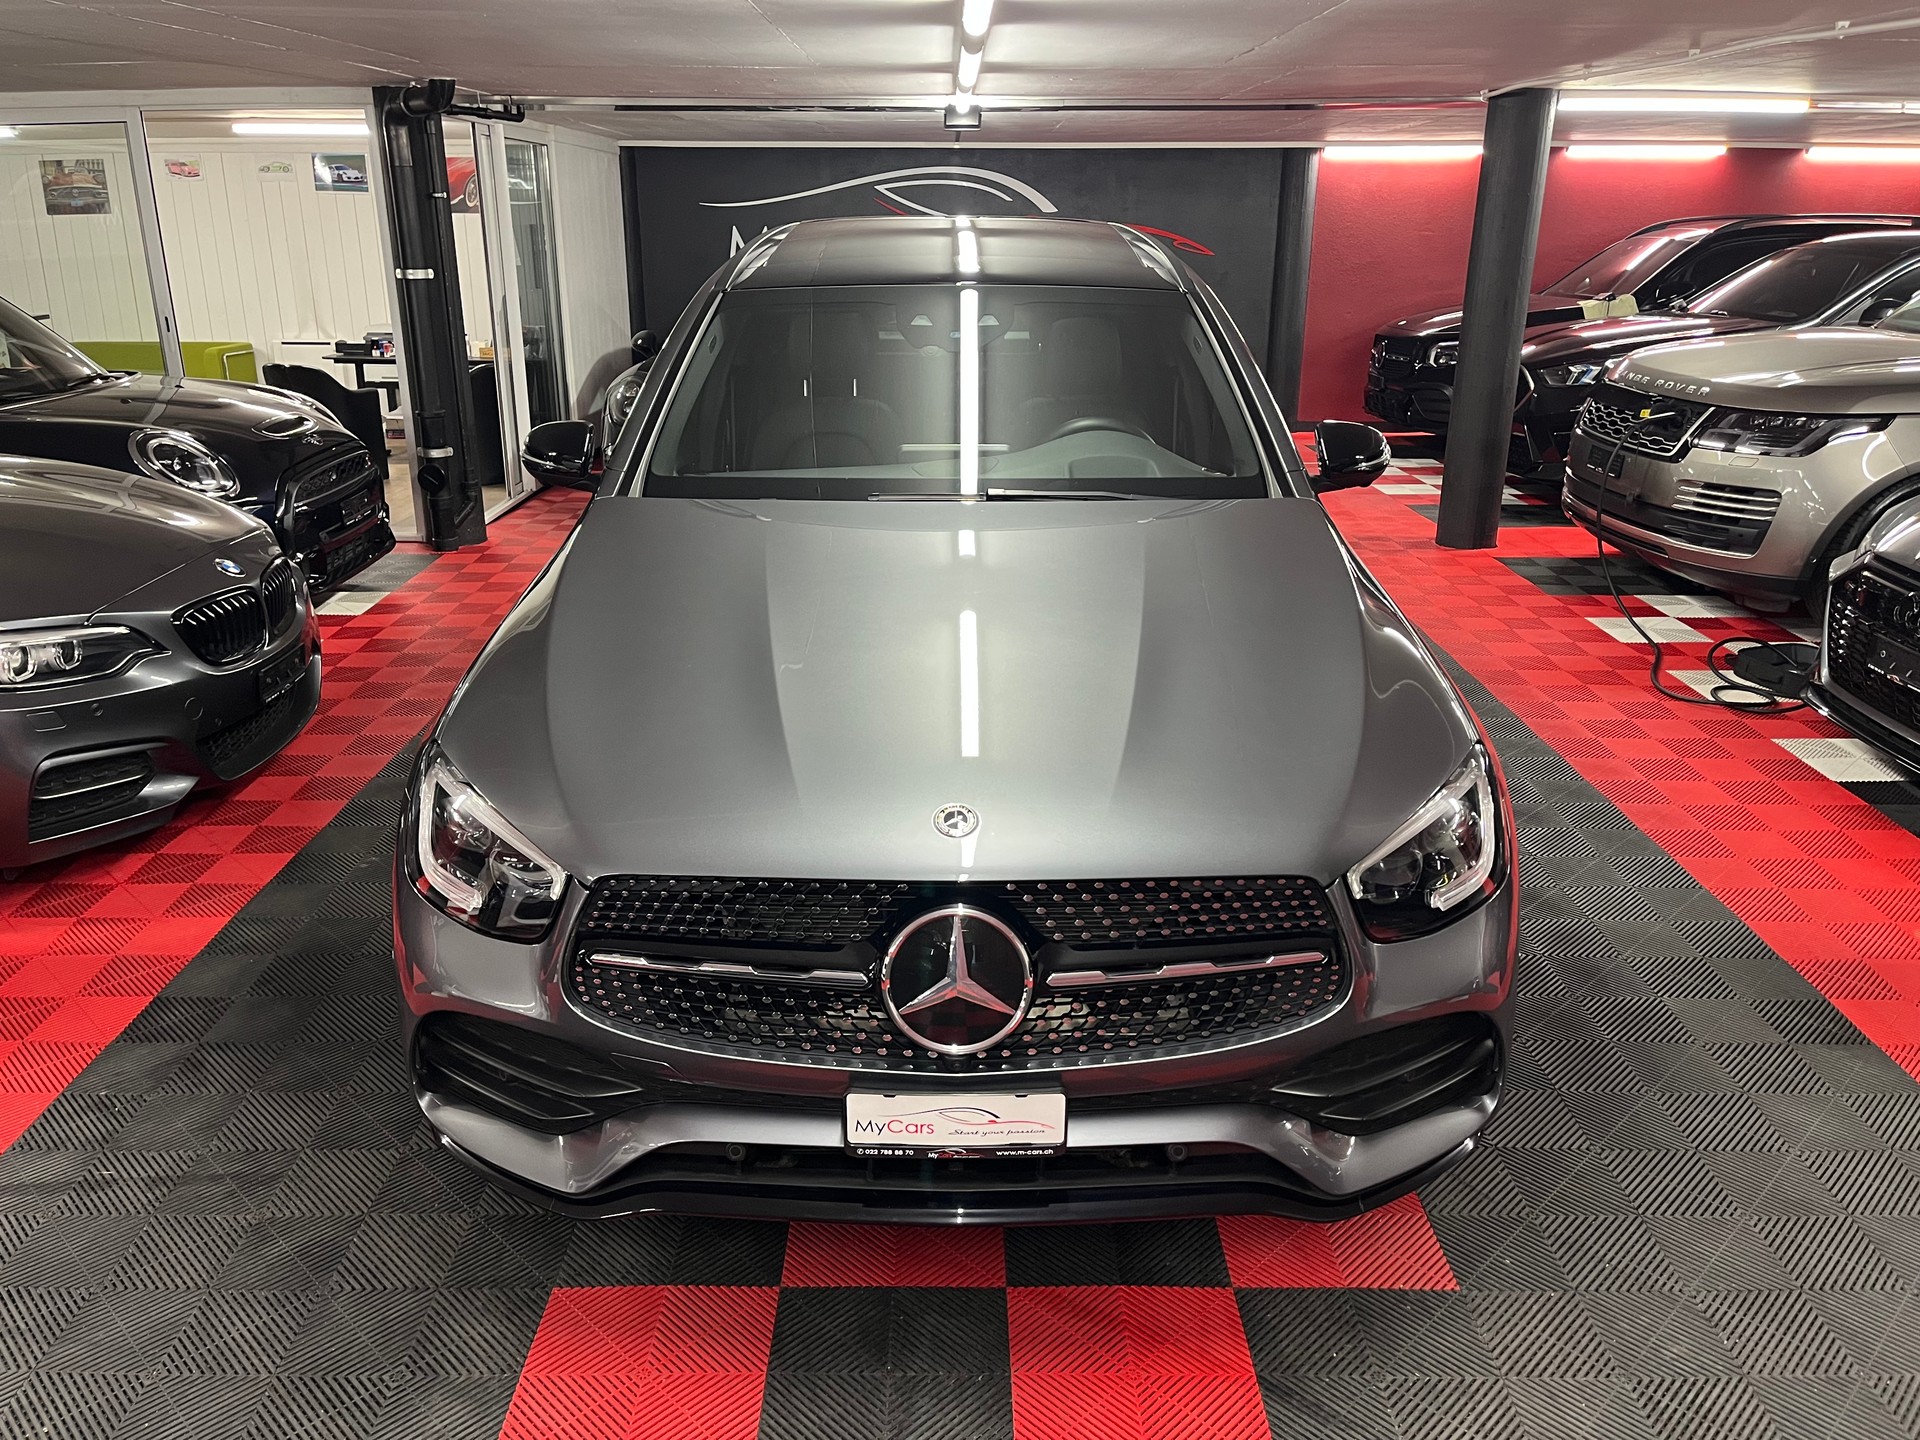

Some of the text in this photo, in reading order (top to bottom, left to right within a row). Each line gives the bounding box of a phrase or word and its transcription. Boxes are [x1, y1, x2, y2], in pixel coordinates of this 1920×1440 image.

[1654, 379, 1711, 396] ROVER
[855, 1119, 935, 1136] MyCars
[948, 1128, 979, 1136] Start
[995, 1148, 1054, 1156] www.m-cars.ch
